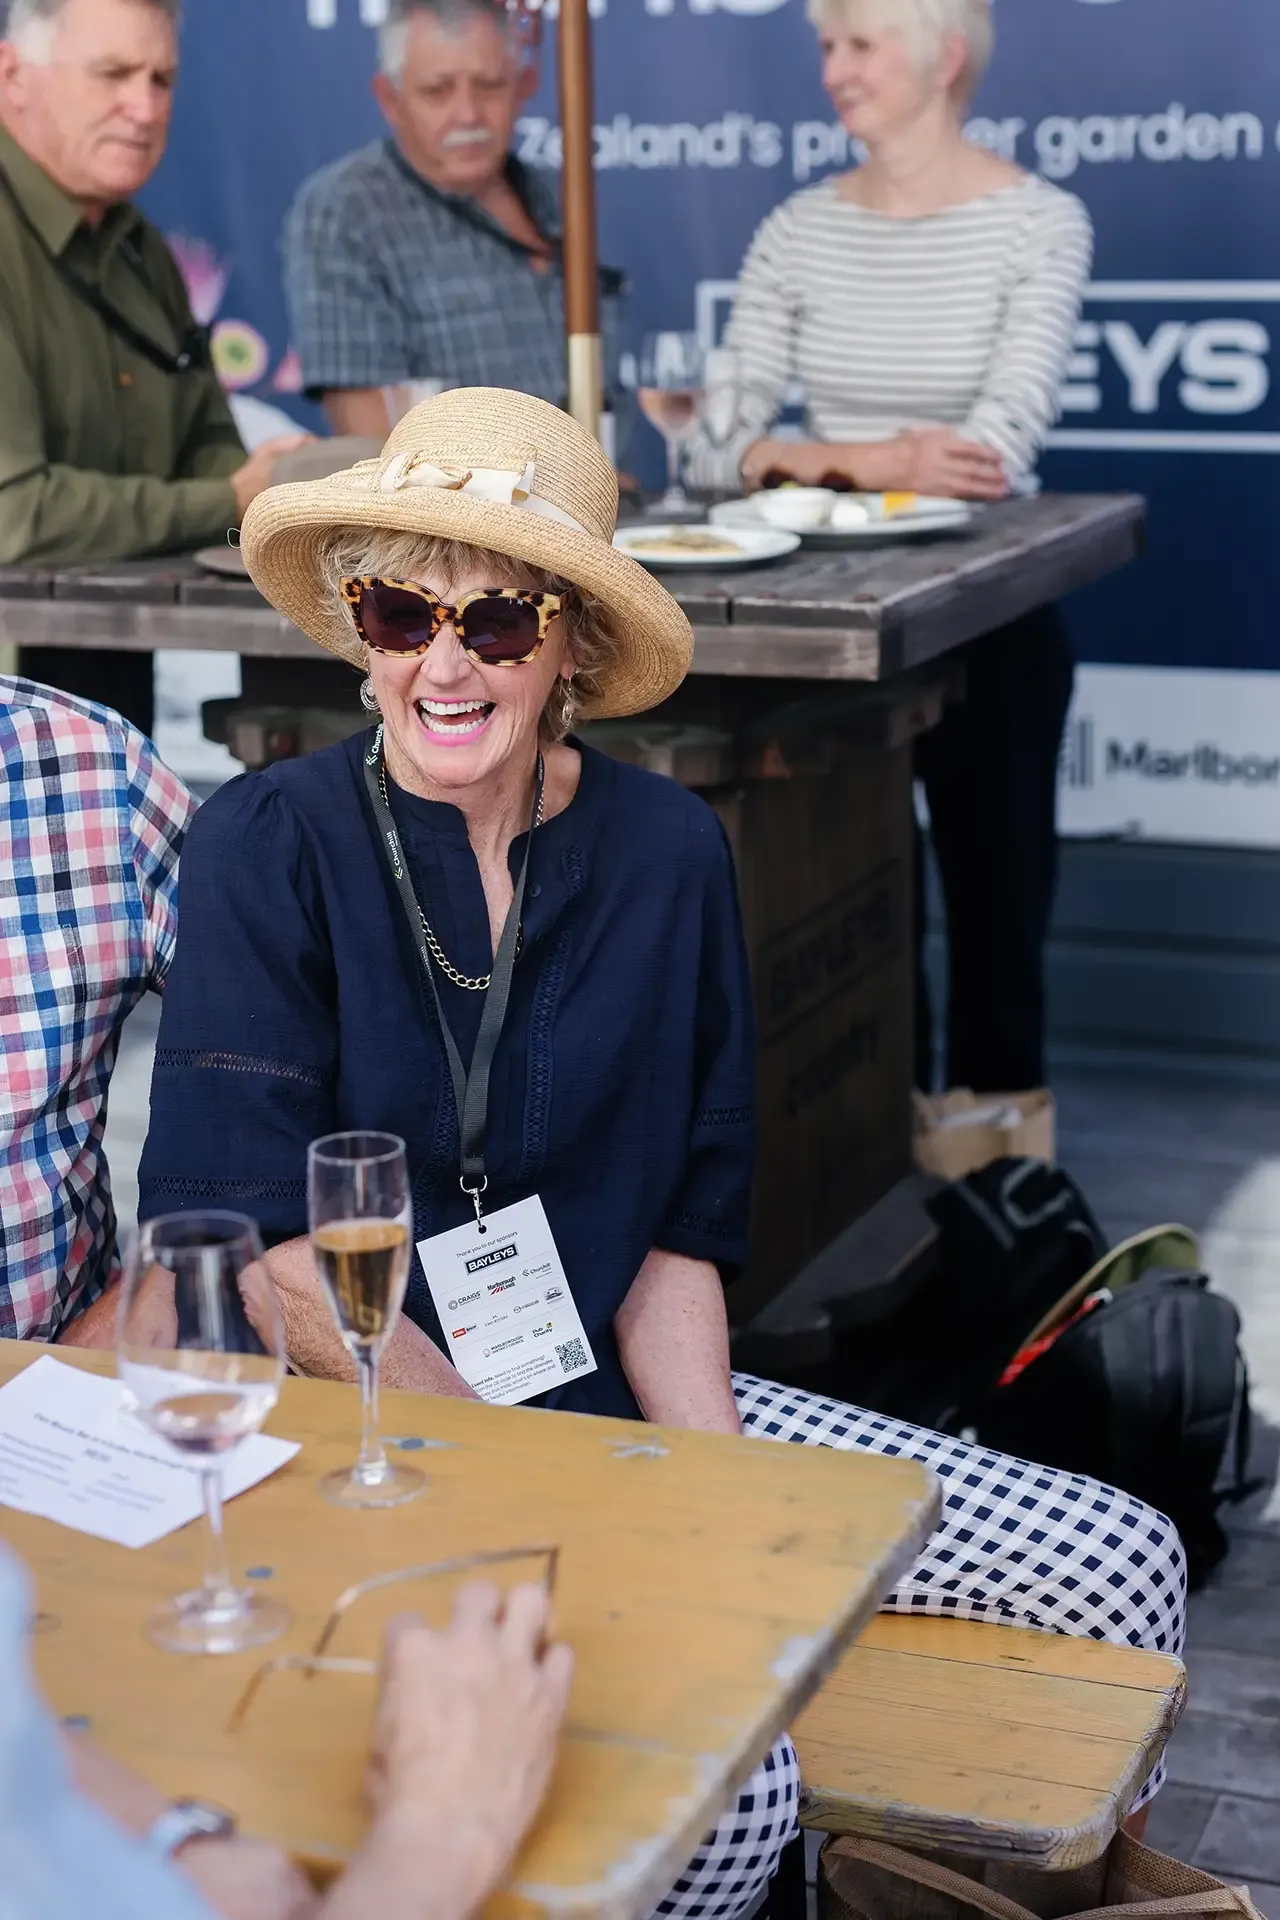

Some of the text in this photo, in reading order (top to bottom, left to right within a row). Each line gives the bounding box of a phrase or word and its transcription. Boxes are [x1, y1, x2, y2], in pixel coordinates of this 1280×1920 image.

[792, 117, 1027, 182] prer
[1034, 102, 1264, 179] garden
[386, 831, 401, 867] Churchill
[456, 1250, 470, 1258] Thank
[496, 1231, 518, 1243] sponsors
[468, 1246, 515, 1271] BAYLEYS
[487, 1276, 516, 1291] Marlborough
[503, 1282, 516, 1291] Lines
[458, 1291, 481, 1304] CRAIGS
[534, 1328, 553, 1338] Charity
